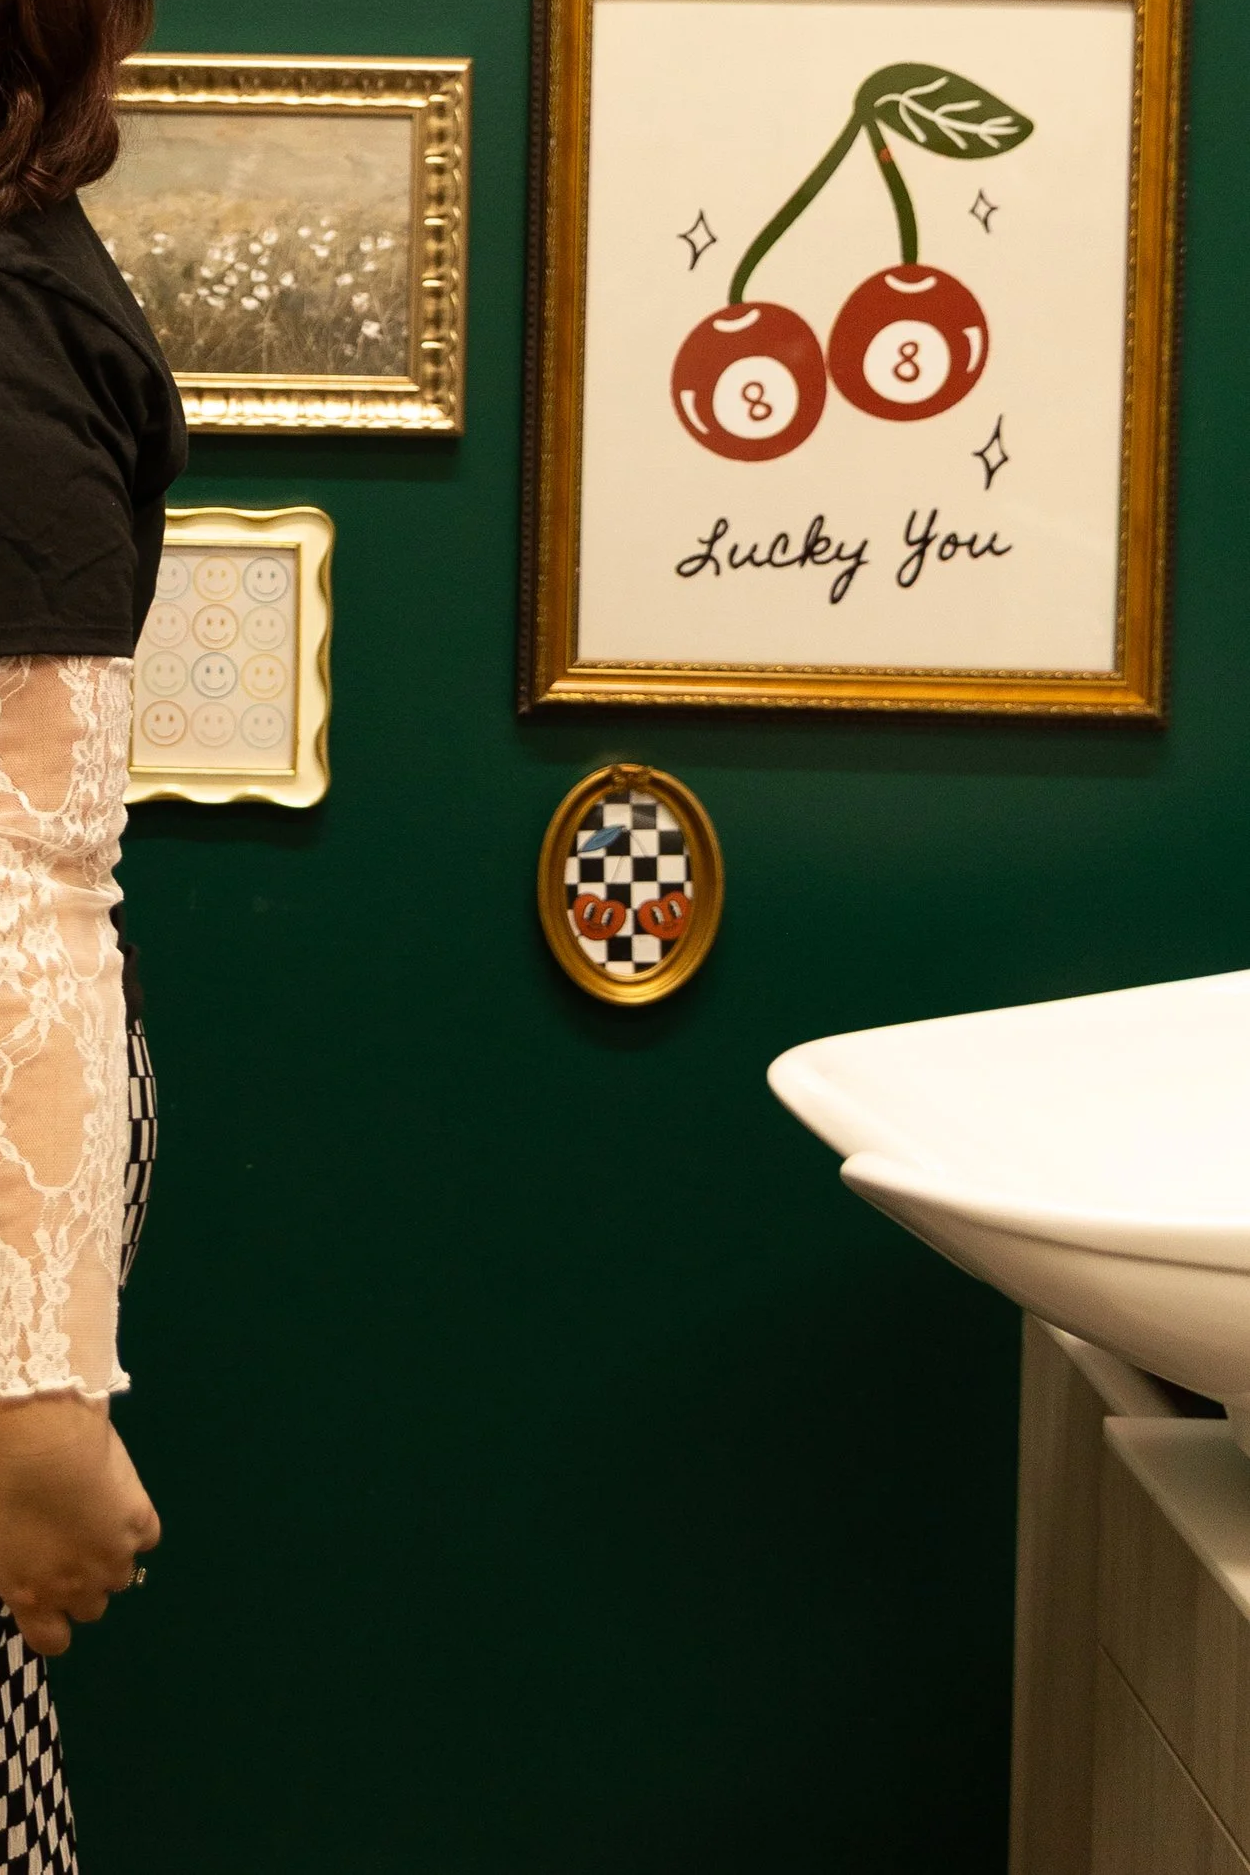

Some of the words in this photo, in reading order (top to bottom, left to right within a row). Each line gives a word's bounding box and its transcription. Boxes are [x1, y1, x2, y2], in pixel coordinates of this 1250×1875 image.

[894, 341, 920, 382] 8
[742, 381, 772, 422] 8
[675, 514, 869, 605] Lucky
[896, 508, 1013, 588] You
